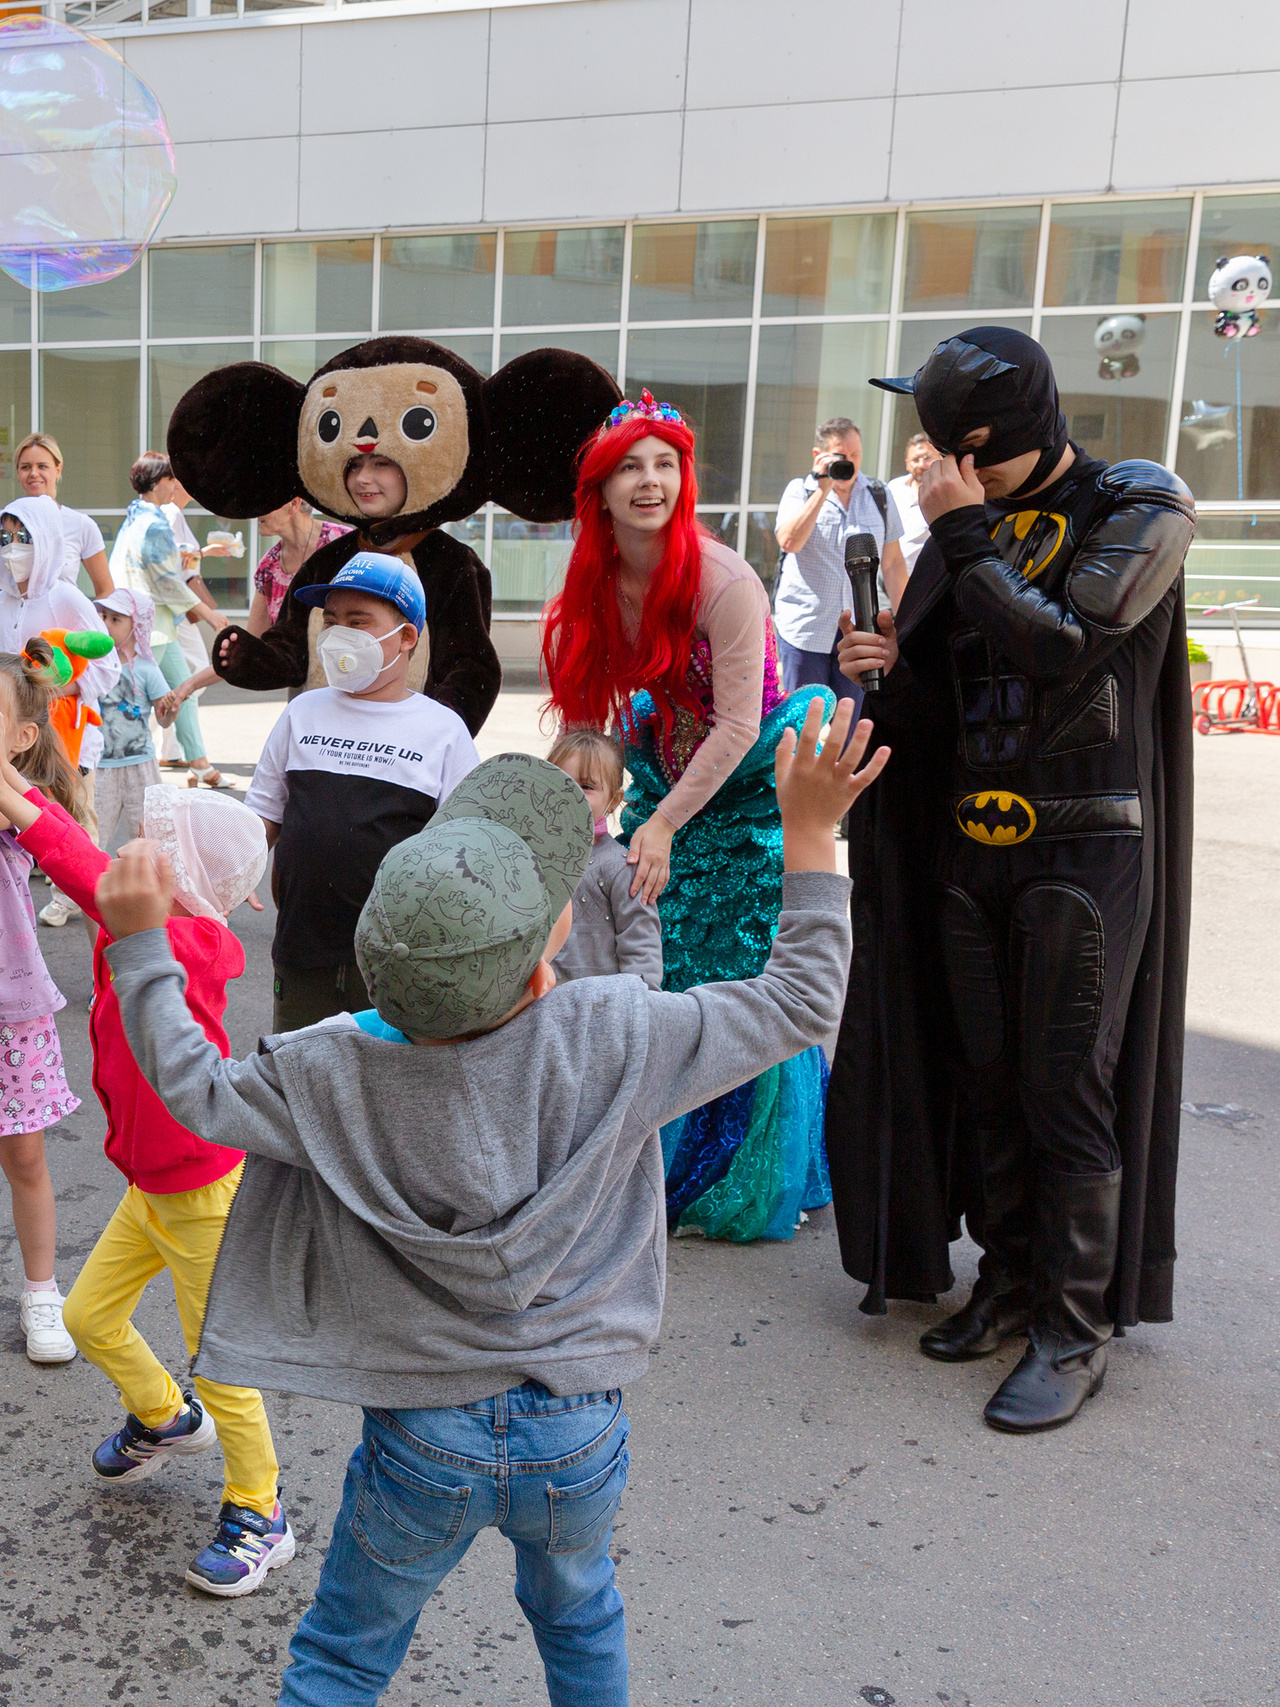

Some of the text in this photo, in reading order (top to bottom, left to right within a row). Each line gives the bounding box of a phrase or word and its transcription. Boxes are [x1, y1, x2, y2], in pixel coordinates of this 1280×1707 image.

[345, 559, 376, 570] EATE
[299, 735, 424, 763] NEVER GIVE UP
[343, 752, 366, 761] FUTURE
[365, 754, 373, 762] IS
